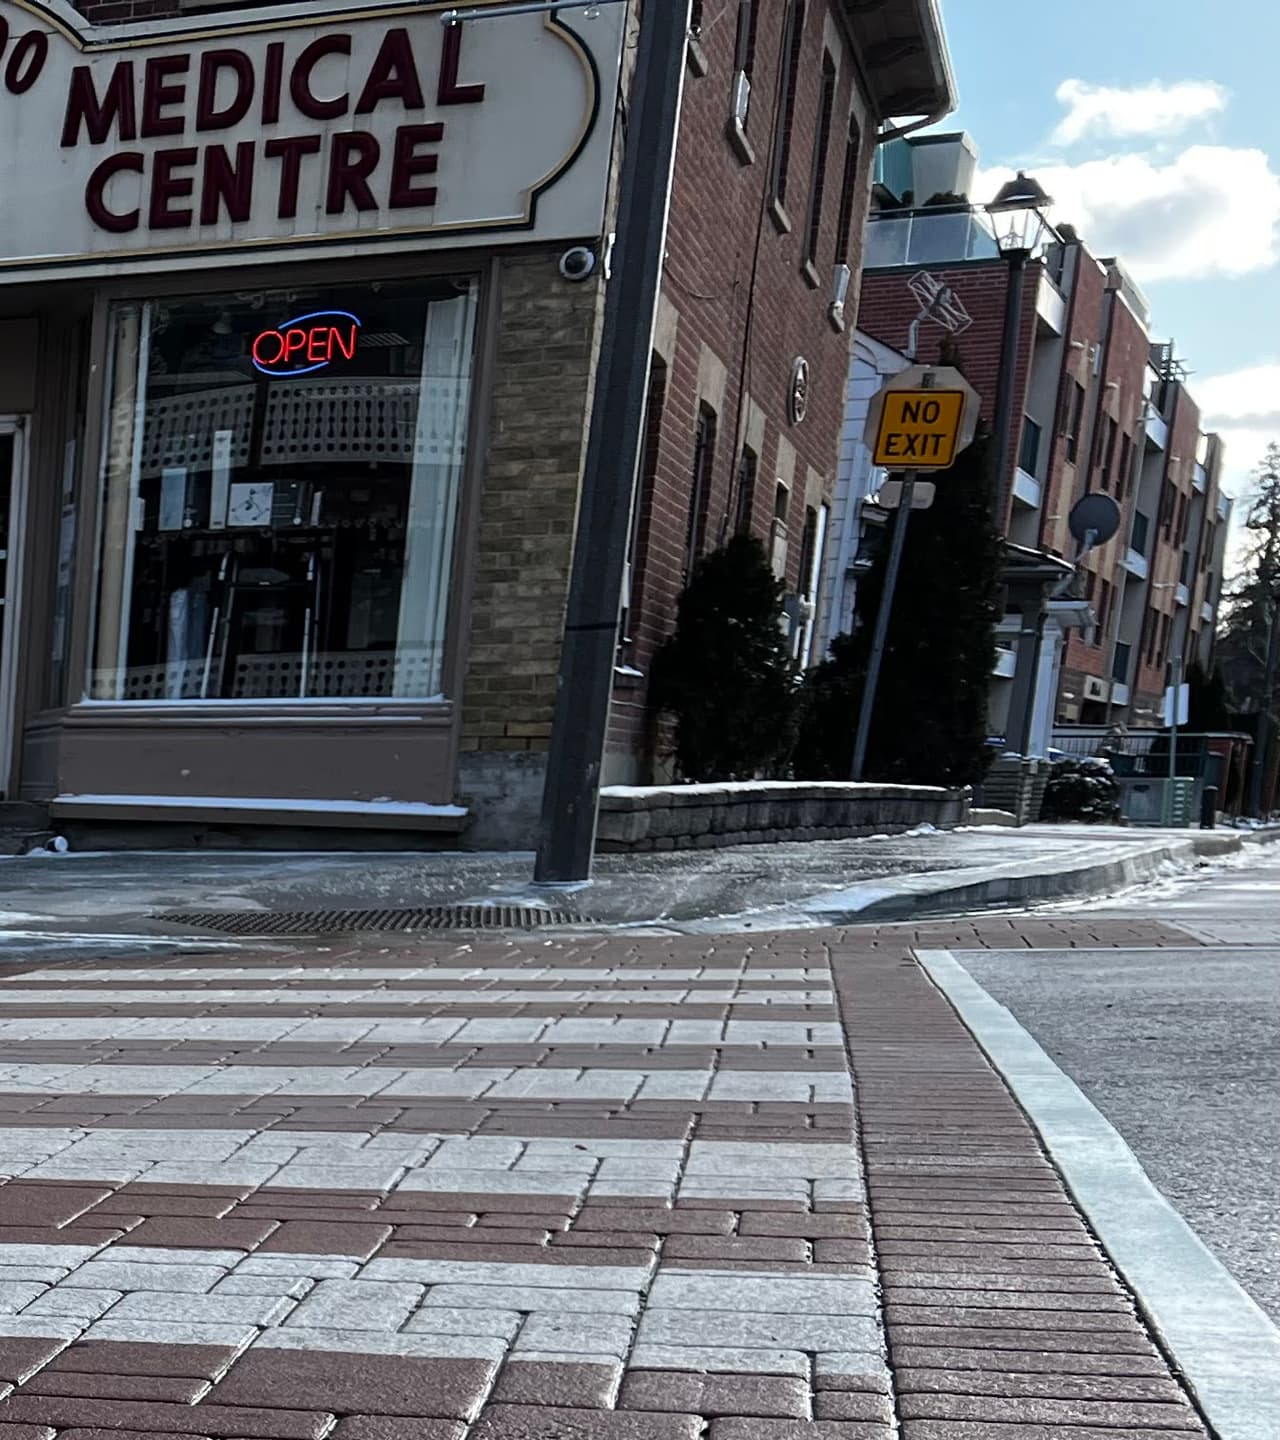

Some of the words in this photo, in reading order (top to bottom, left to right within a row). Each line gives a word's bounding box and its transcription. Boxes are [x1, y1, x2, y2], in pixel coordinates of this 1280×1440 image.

[60, 22, 486, 148] MEDICAL
[84, 122, 445, 234] CENTRE
[252, 323, 358, 366] OPEN
[900, 400, 940, 425] NO
[884, 433, 947, 457] EXIT
